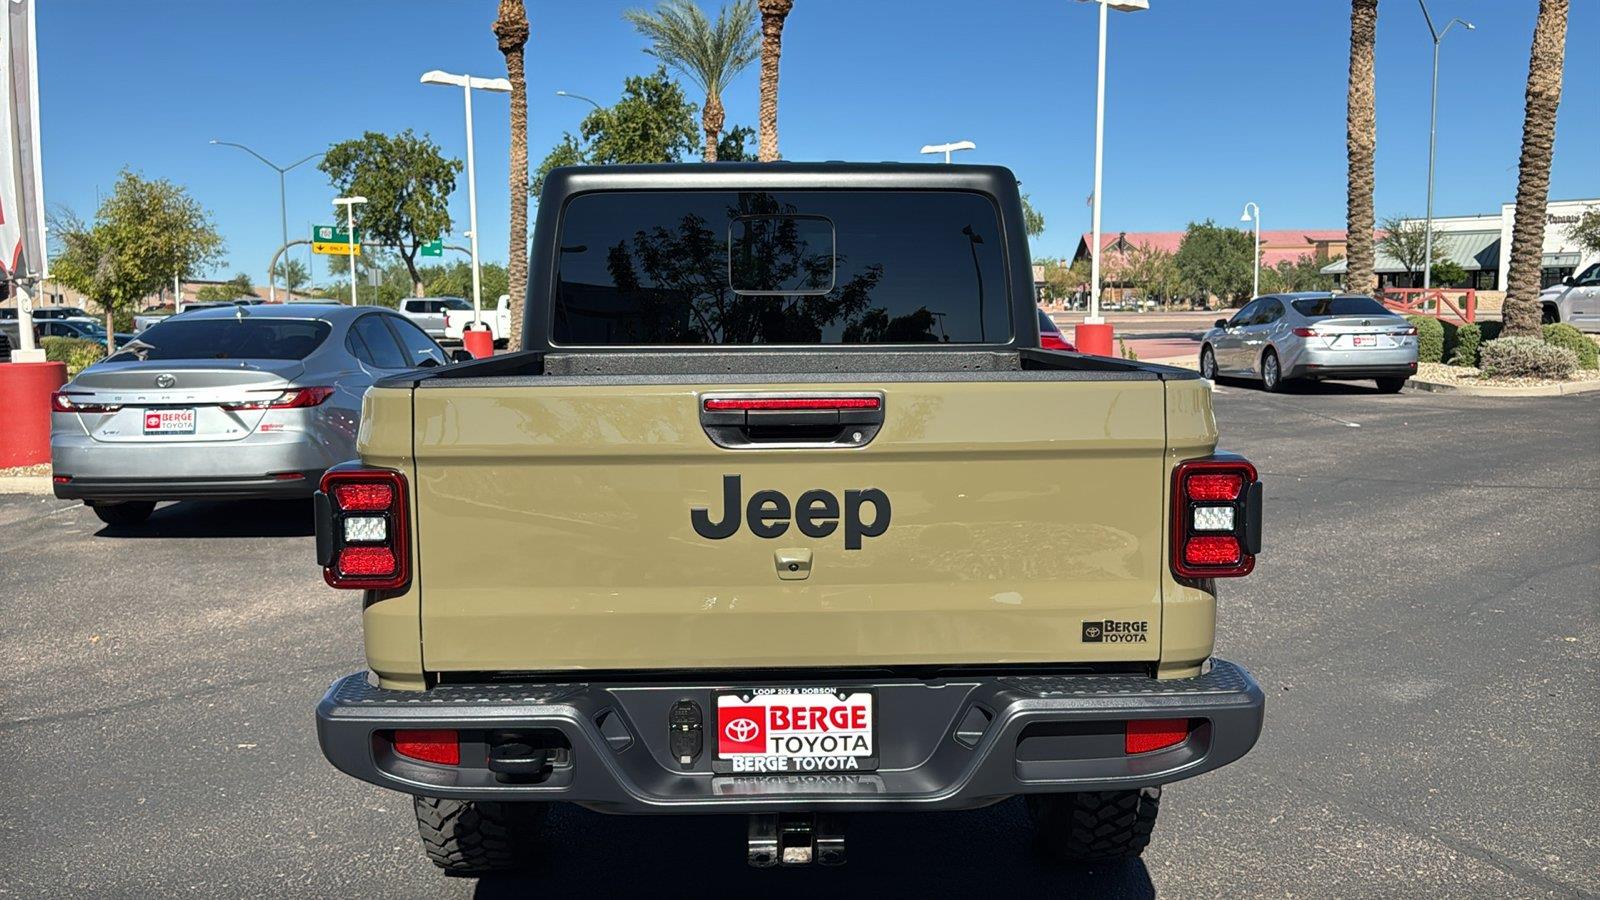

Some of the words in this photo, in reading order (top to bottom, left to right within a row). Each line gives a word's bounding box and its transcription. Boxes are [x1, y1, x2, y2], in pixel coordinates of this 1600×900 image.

[162, 414, 192, 422] BERGE
[691, 474, 891, 550] Jeep
[1104, 620, 1148, 633] BERGE
[1104, 634, 1147, 642] TOYOTA
[770, 705, 867, 732] BERGE
[770, 735, 869, 754] TOYOTA
[732, 756, 788, 772] BERGE
[793, 756, 859, 770] TOYOTA
